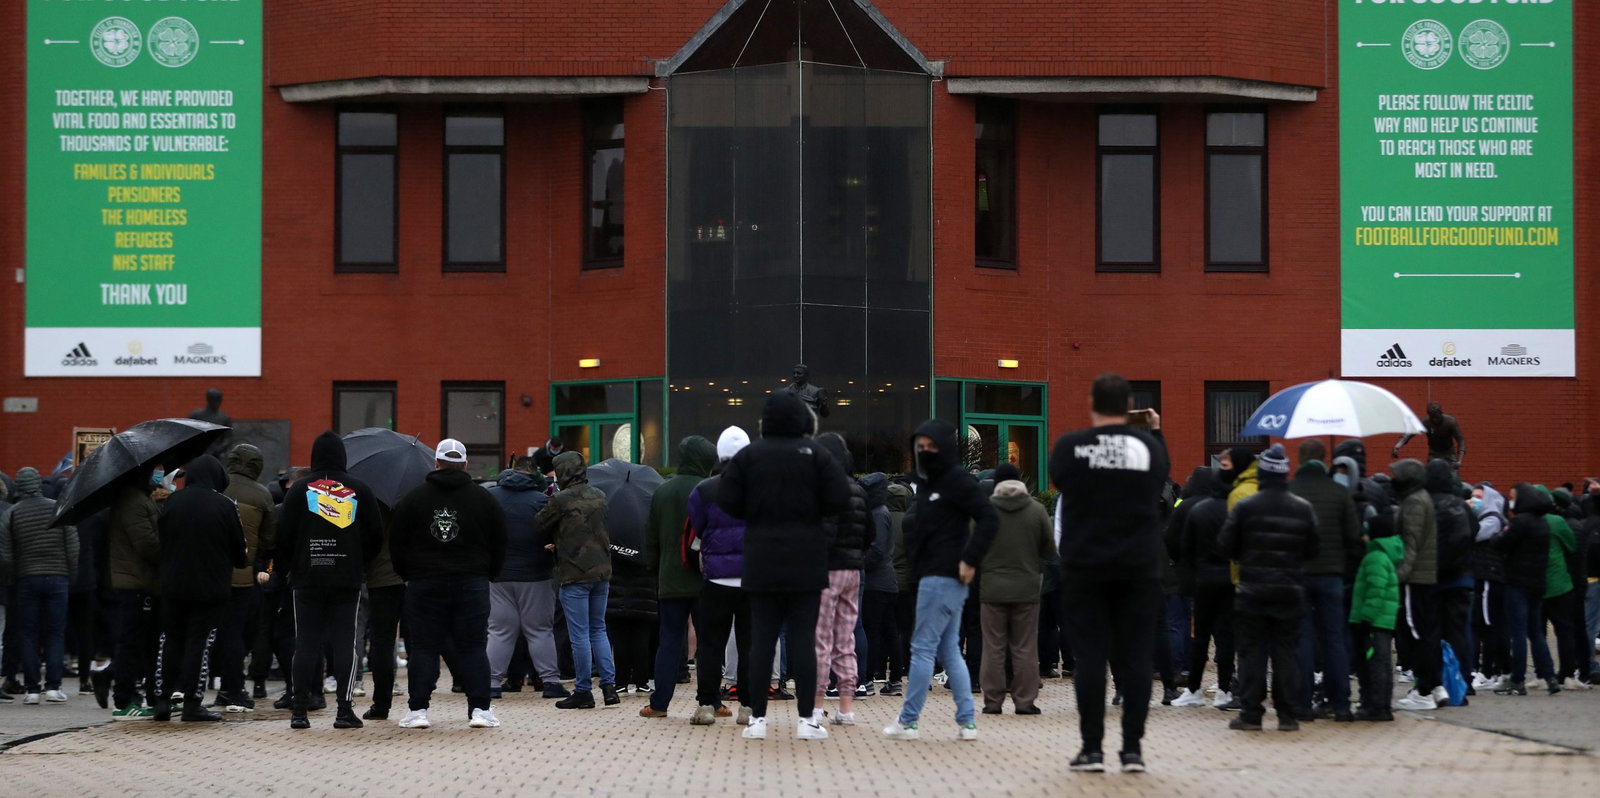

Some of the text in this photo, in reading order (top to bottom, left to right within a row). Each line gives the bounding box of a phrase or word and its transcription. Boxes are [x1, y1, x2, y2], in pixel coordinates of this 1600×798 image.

[56, 90, 233, 107] TOGETHER, WE HAVE PROVIDED
[1379, 95, 1533, 110] PLEASE FOLLOW THE CELTIC
[53, 113, 235, 129] VITAL FOOD AND ESSENTIALS TO
[1374, 117, 1538, 133] WAY AND HELP US CONTINUE
[60, 135, 228, 151] THOUSANDS OF VULNERABLE:
[1380, 140, 1532, 155] TO REACH THOSE WHO ARE
[75, 164, 126, 180] FAMILIES
[141, 164, 214, 180] INDIVIDUALS
[1415, 162, 1497, 178] MOST IN NEED.
[109, 186, 180, 202] PENSIONERS
[102, 209, 186, 225] THE HOMELESS
[1361, 206, 1552, 221] YOU CAN LEND YOUR SUPPORT AT
[116, 232, 172, 248] REFUGEES
[1356, 227, 1558, 245] FOOTBALLFORGOODFUND.COM
[113, 255, 174, 270] NHS STAFF
[101, 284, 187, 304] THANK YOU
[62, 357, 97, 366] adidas
[115, 357, 157, 366] dafabet
[1377, 359, 1412, 367] adidas
[1429, 357, 1471, 368] dafabet
[1096, 434, 1126, 446] THE
[1074, 445, 1126, 458] NORTH
[1088, 457, 1126, 469] FACE
[608, 544, 639, 555] UNLOP
